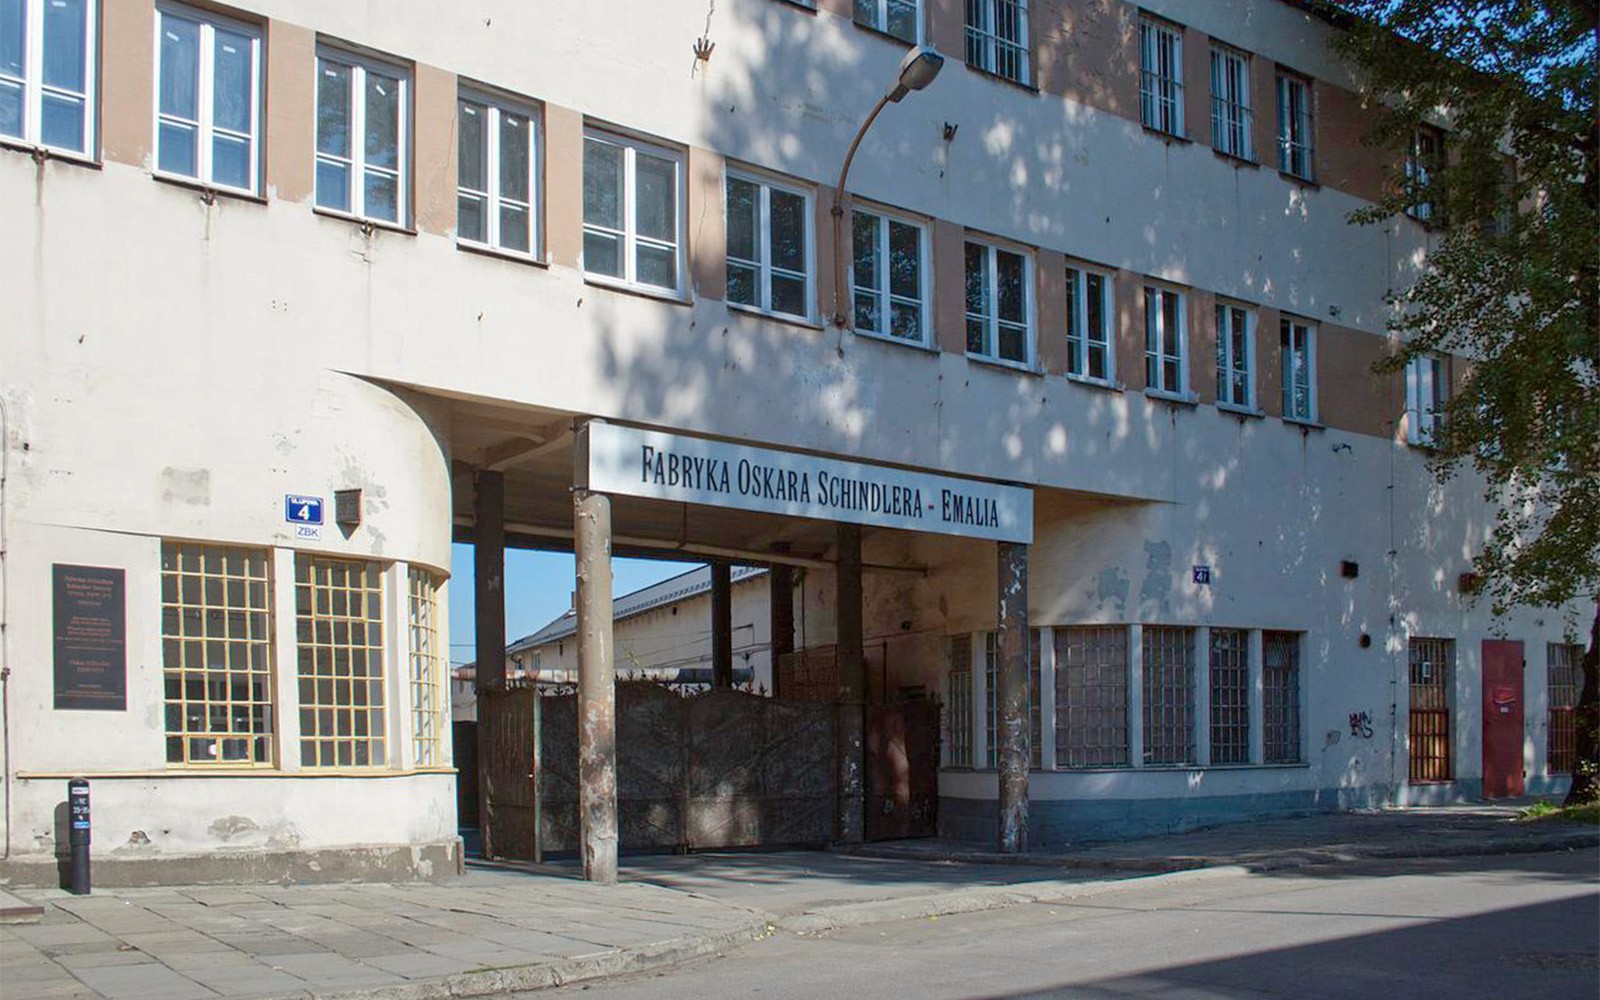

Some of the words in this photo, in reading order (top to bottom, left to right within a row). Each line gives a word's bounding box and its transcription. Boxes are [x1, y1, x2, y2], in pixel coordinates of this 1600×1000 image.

[641, 444, 730, 494] FABRYKA
[737, 458, 811, 504] OSKARA
[817, 470, 923, 519] SCHINDLERA
[941, 488, 1000, 529] EMALIA
[297, 504, 310, 520] 4
[297, 526, 319, 537] ZBK
